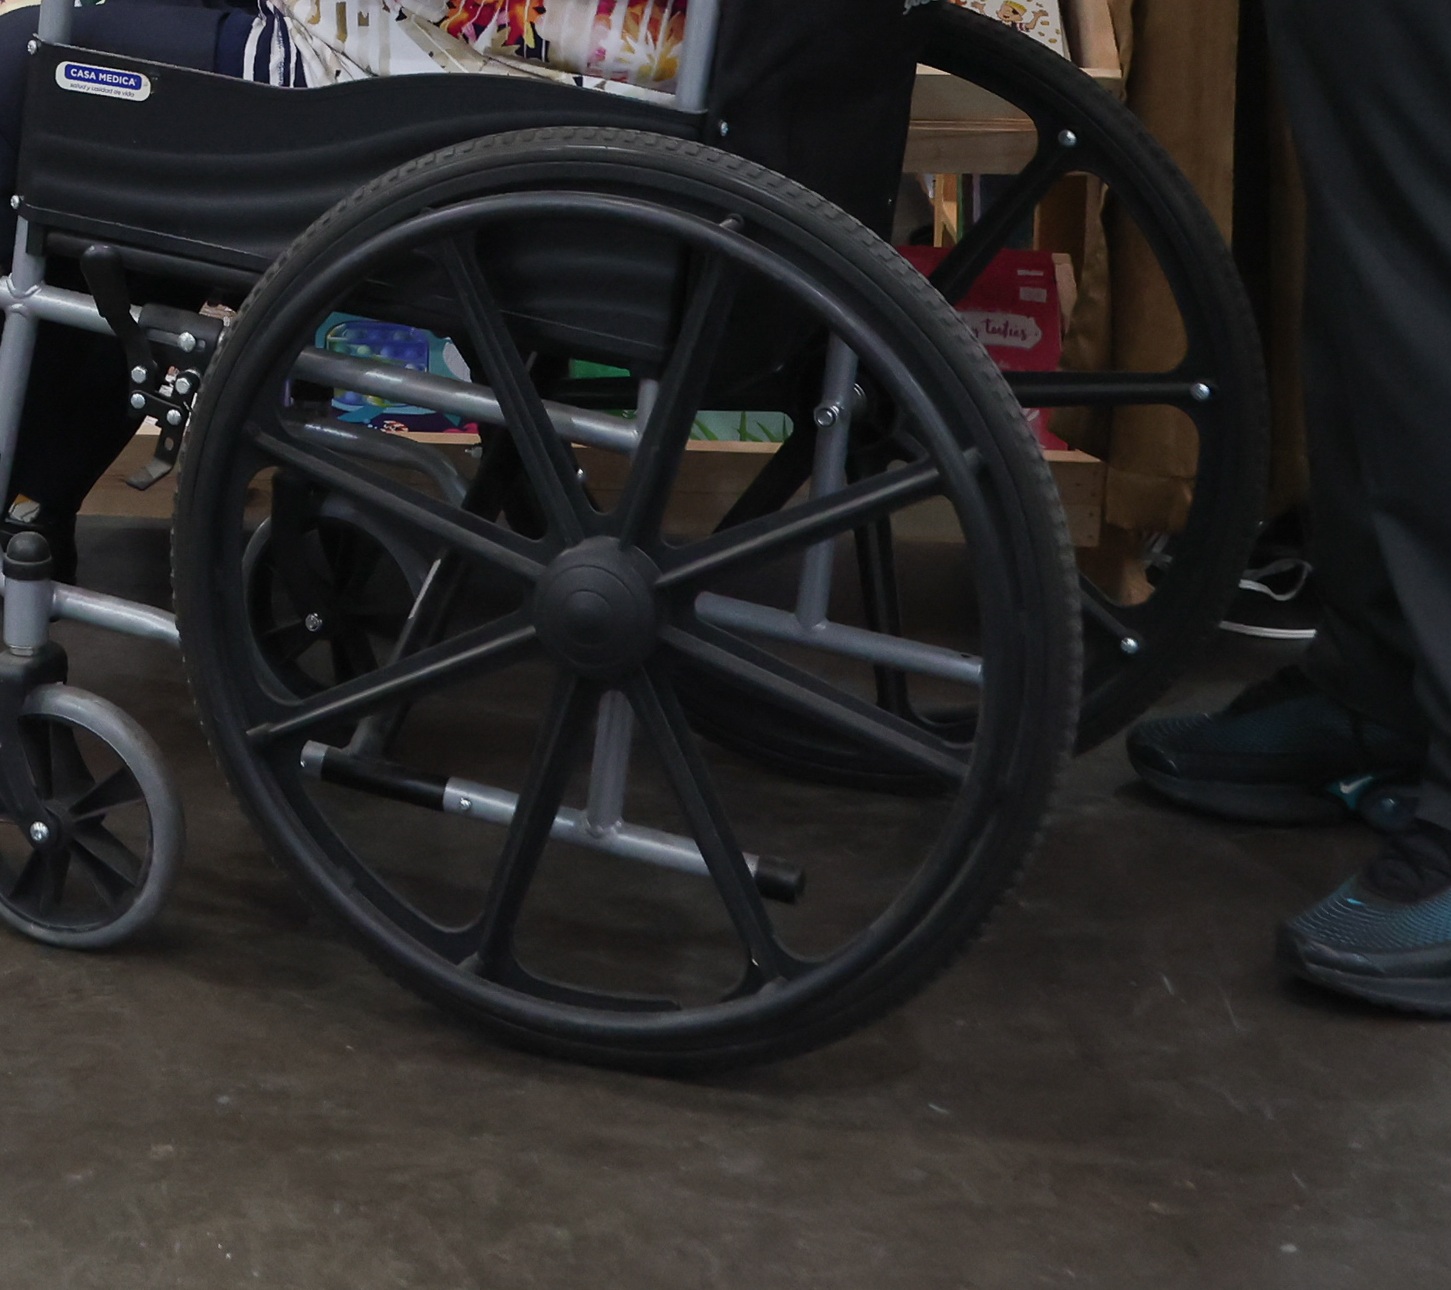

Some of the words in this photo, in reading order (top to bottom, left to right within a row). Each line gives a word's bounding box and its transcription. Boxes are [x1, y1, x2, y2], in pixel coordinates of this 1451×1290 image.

[70, 67, 96, 82] CASA
[98, 71, 137, 87] MEDICA
[69, 82, 87, 90] salud
[91, 84, 111, 94] calidad
[121, 89, 135, 97] vida
